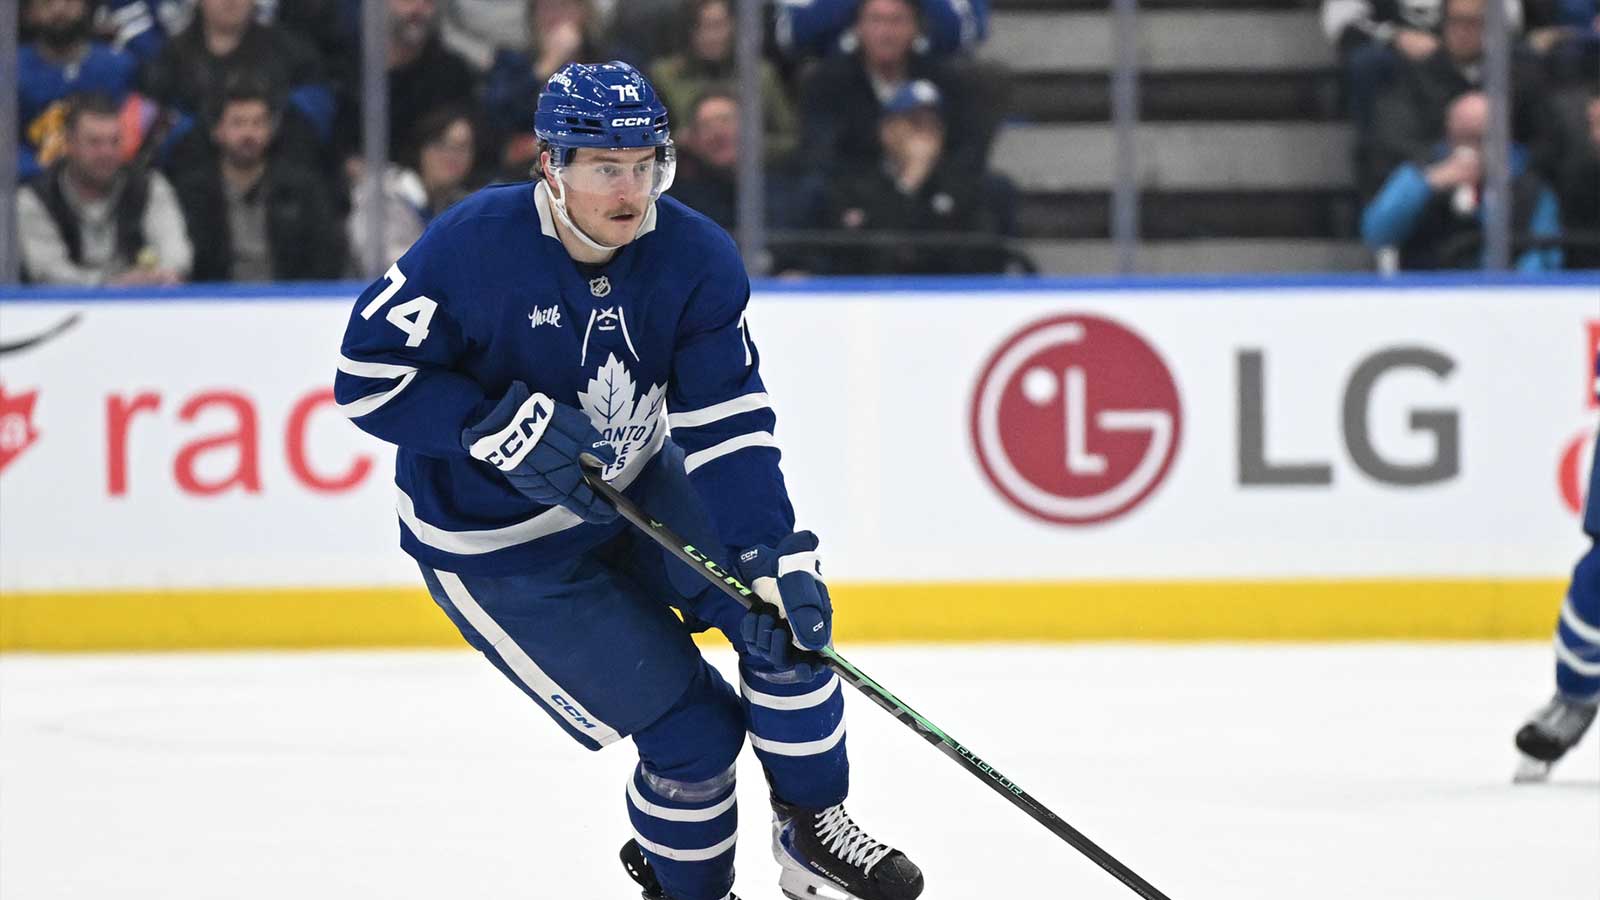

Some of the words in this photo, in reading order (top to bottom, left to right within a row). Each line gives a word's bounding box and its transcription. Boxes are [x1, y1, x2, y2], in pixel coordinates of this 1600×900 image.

[610, 84, 640, 102] 74
[611, 117, 651, 127] CCM
[360, 262, 438, 348] 74
[528, 304, 562, 329] Milk
[485, 401, 549, 468] CCM
[602, 425, 647, 442] ONTO
[1236, 345, 1462, 489] LG
[683, 544, 752, 597] CCM
[740, 549, 759, 561] CCM
[551, 694, 597, 729] CCM
[956, 744, 1024, 796] RIBCOR
